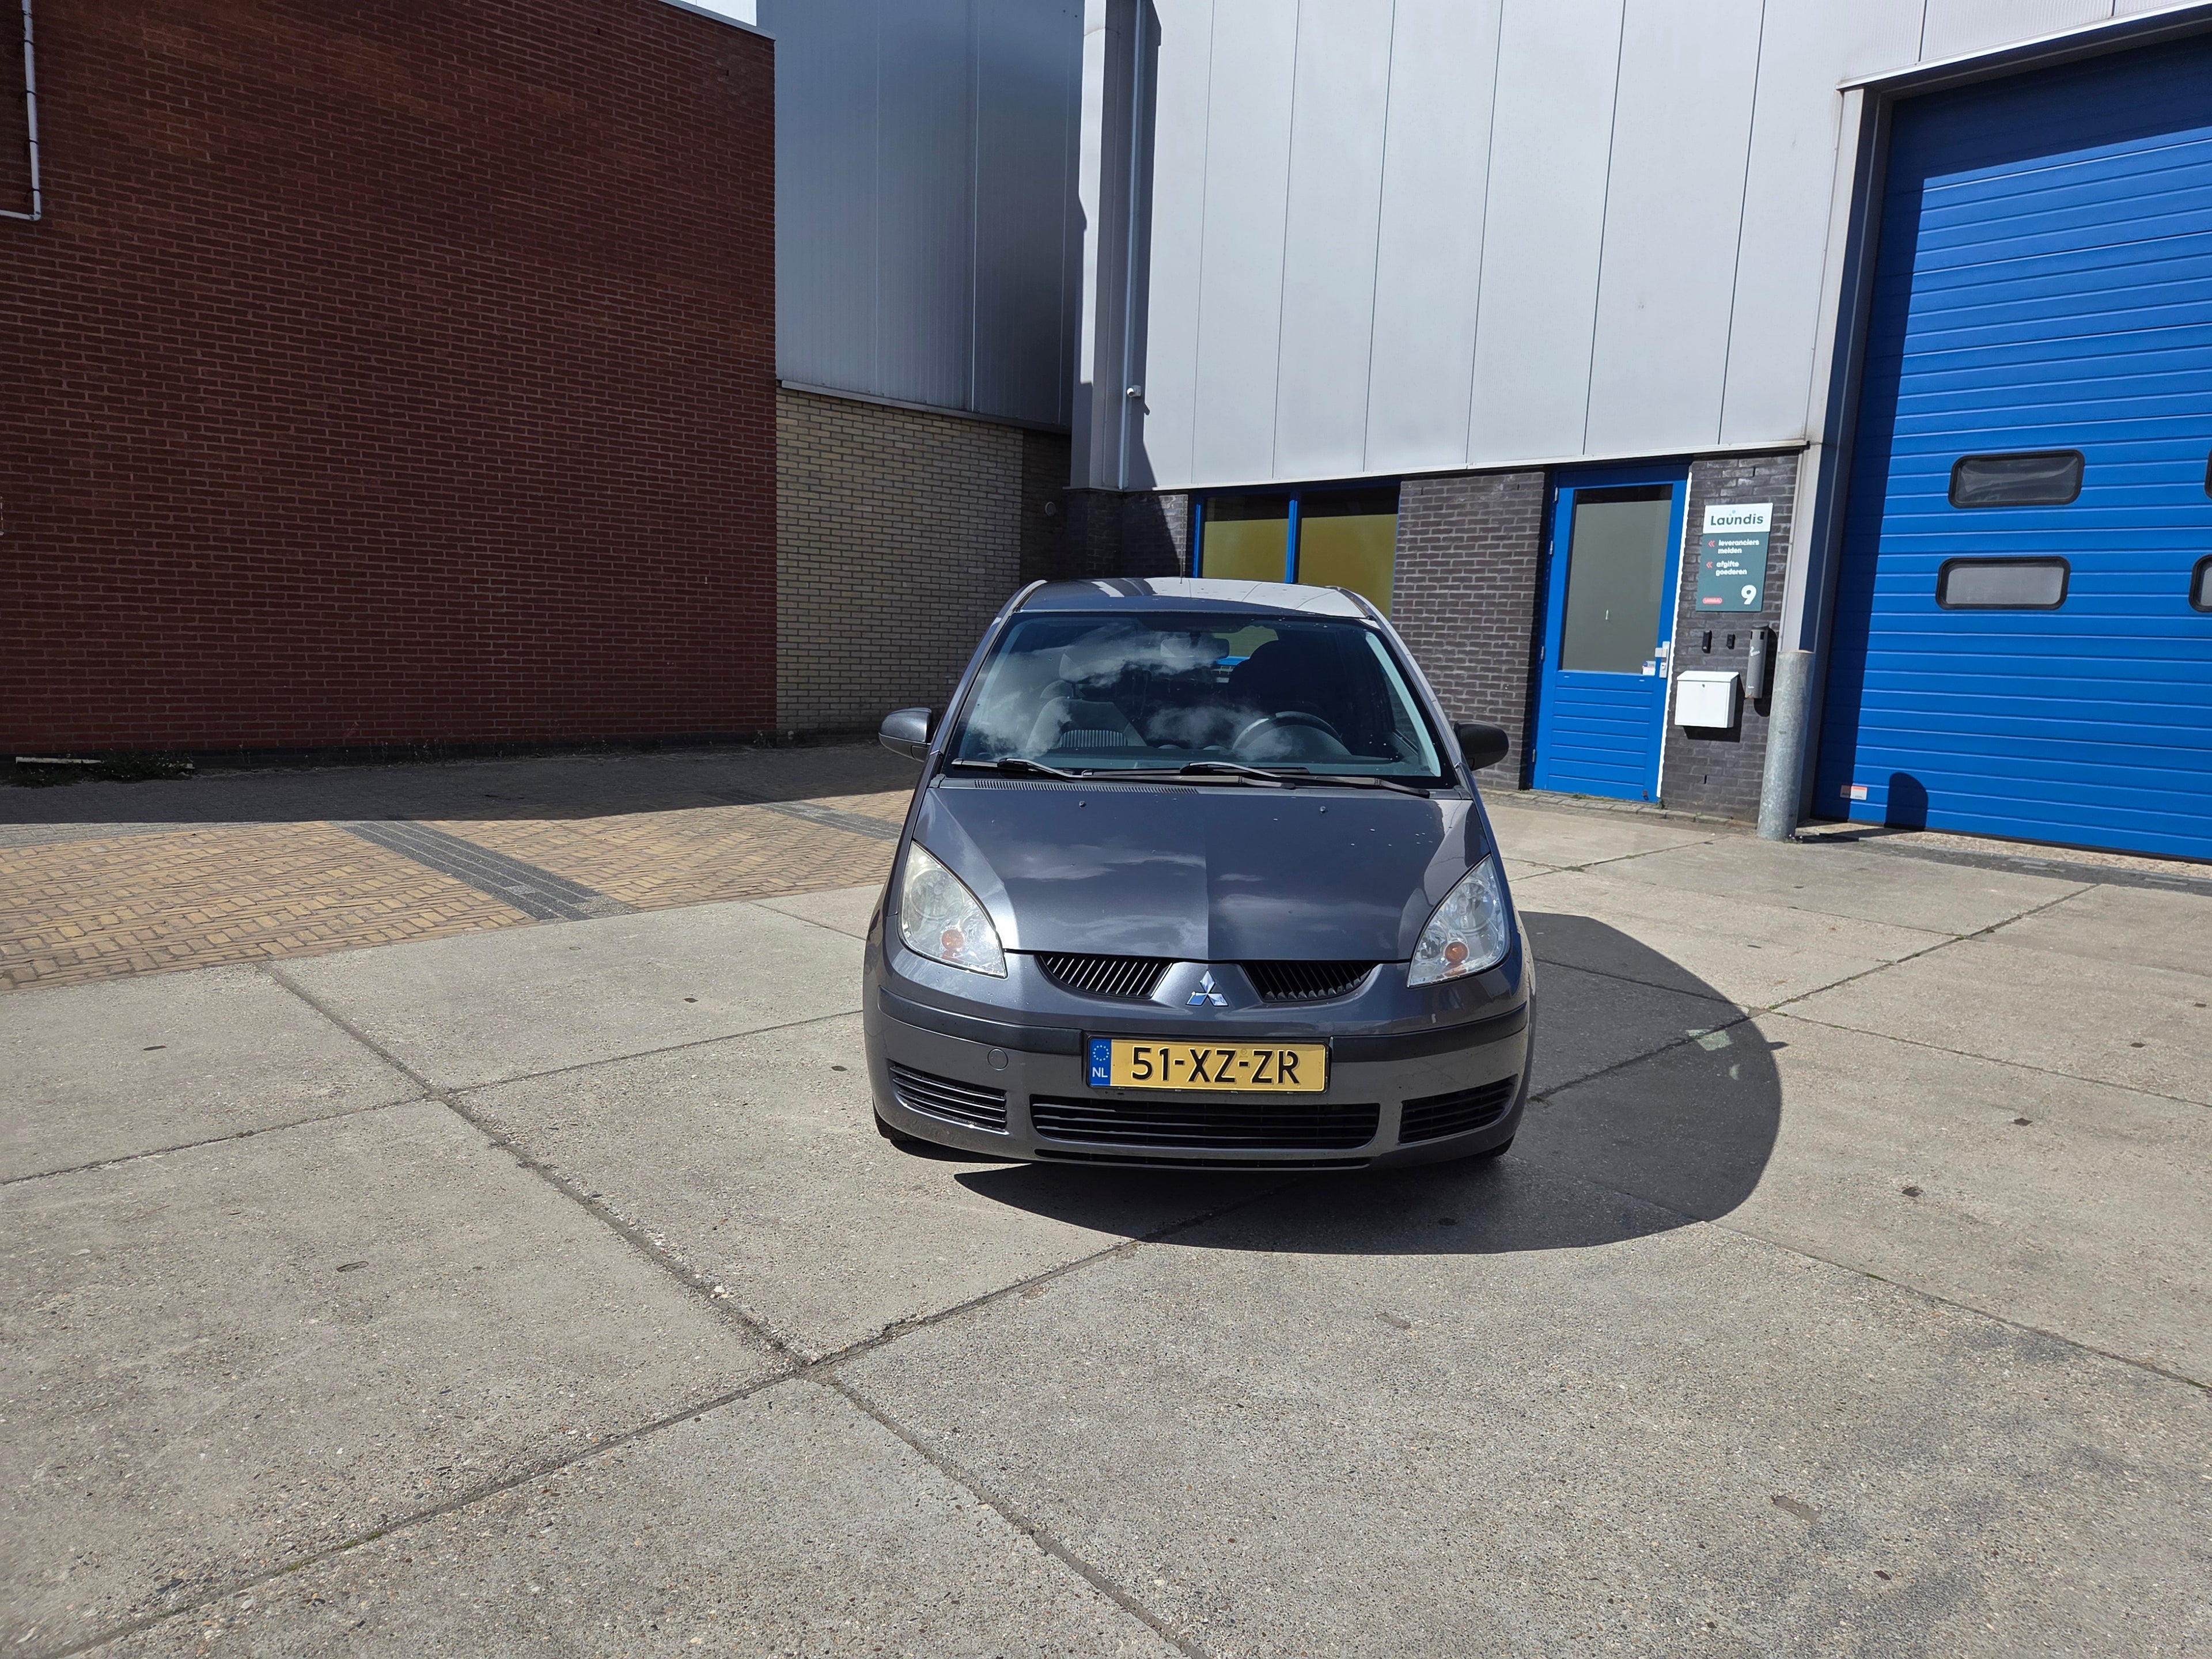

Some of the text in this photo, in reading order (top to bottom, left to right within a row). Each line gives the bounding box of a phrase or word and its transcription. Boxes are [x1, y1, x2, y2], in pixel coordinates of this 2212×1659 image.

[1710, 514, 1764, 525] Laundis
[1716, 560, 1740, 569] afgifte
[1715, 568, 1748, 577] goederen
[1741, 584, 1757, 605] 9
[1131, 1046, 1300, 1084] 51-XZ-ZR
[1092, 1067, 1108, 1078] NL
